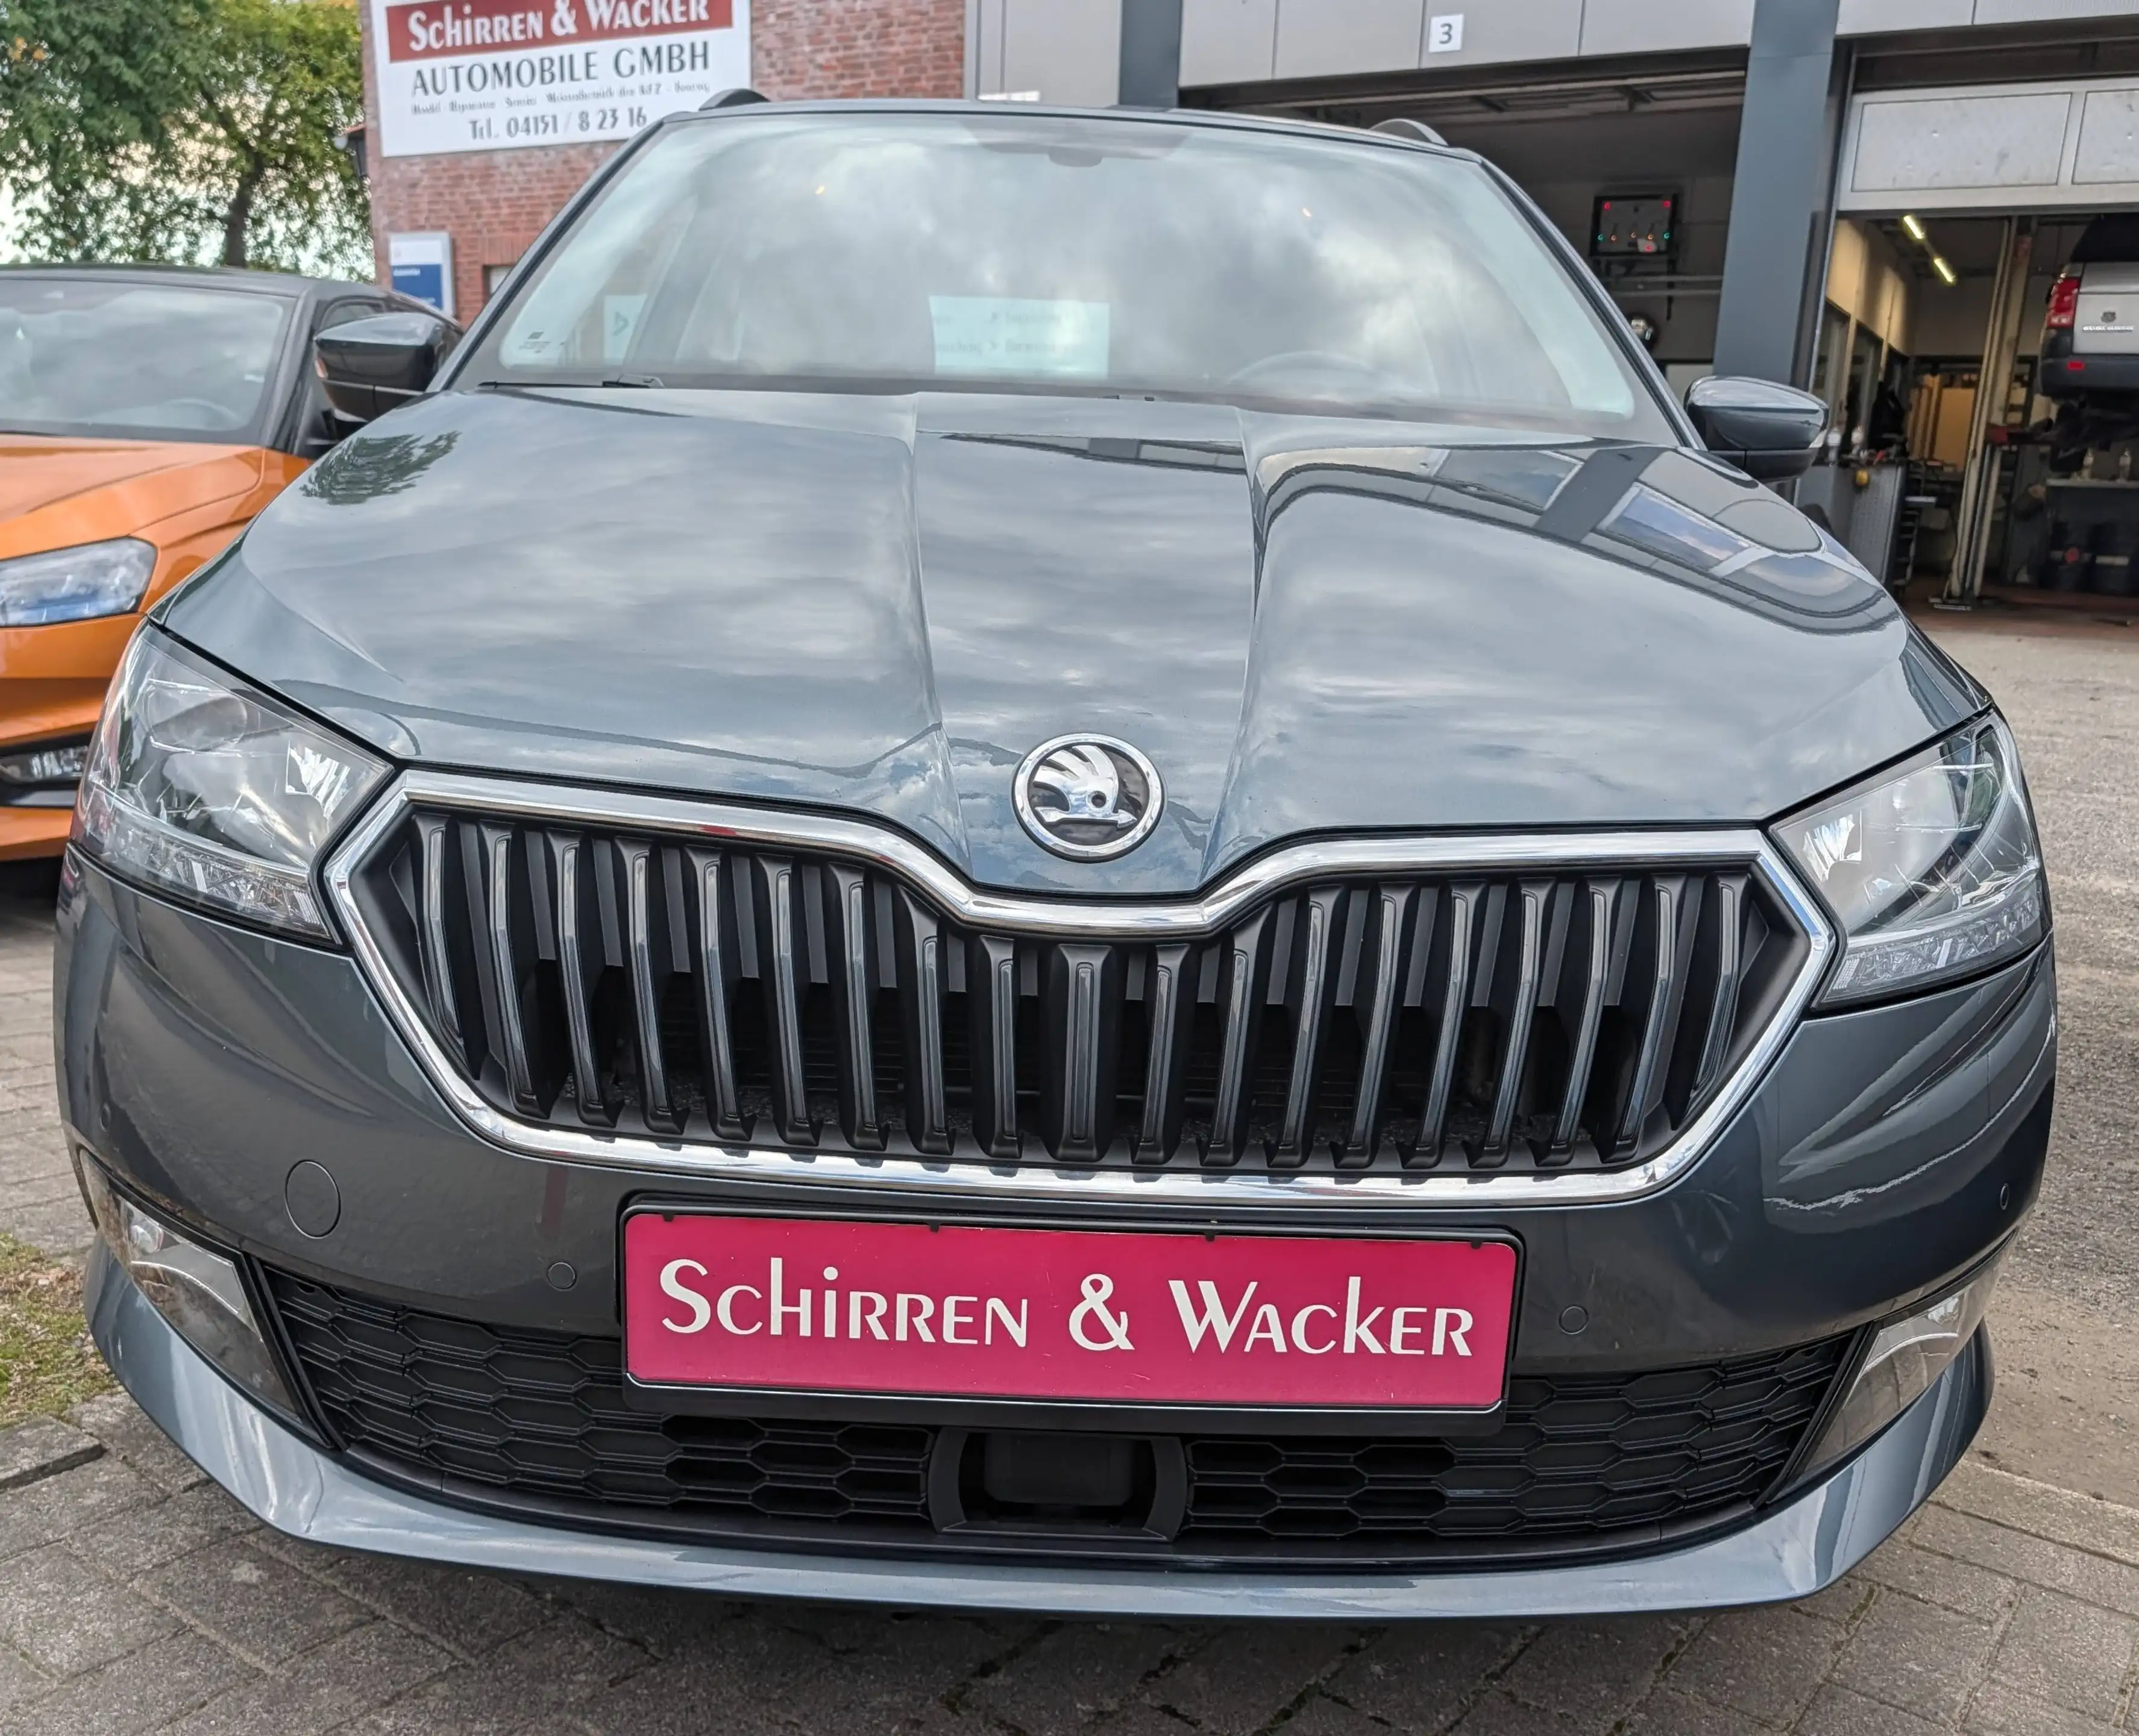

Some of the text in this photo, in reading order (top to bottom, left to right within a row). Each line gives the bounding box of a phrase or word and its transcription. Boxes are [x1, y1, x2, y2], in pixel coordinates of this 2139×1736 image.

[550, 0, 578, 36] &
[1439, 23, 1453, 44] 3
[411, 51, 600, 96] AUTOMOBILE
[613, 41, 709, 78] GMBH
[506, 114, 558, 138] 04151
[577, 110, 590, 132] 8
[597, 108, 619, 130] 23
[627, 107, 647, 128] 16
[1069, 1274, 1135, 1351] &
